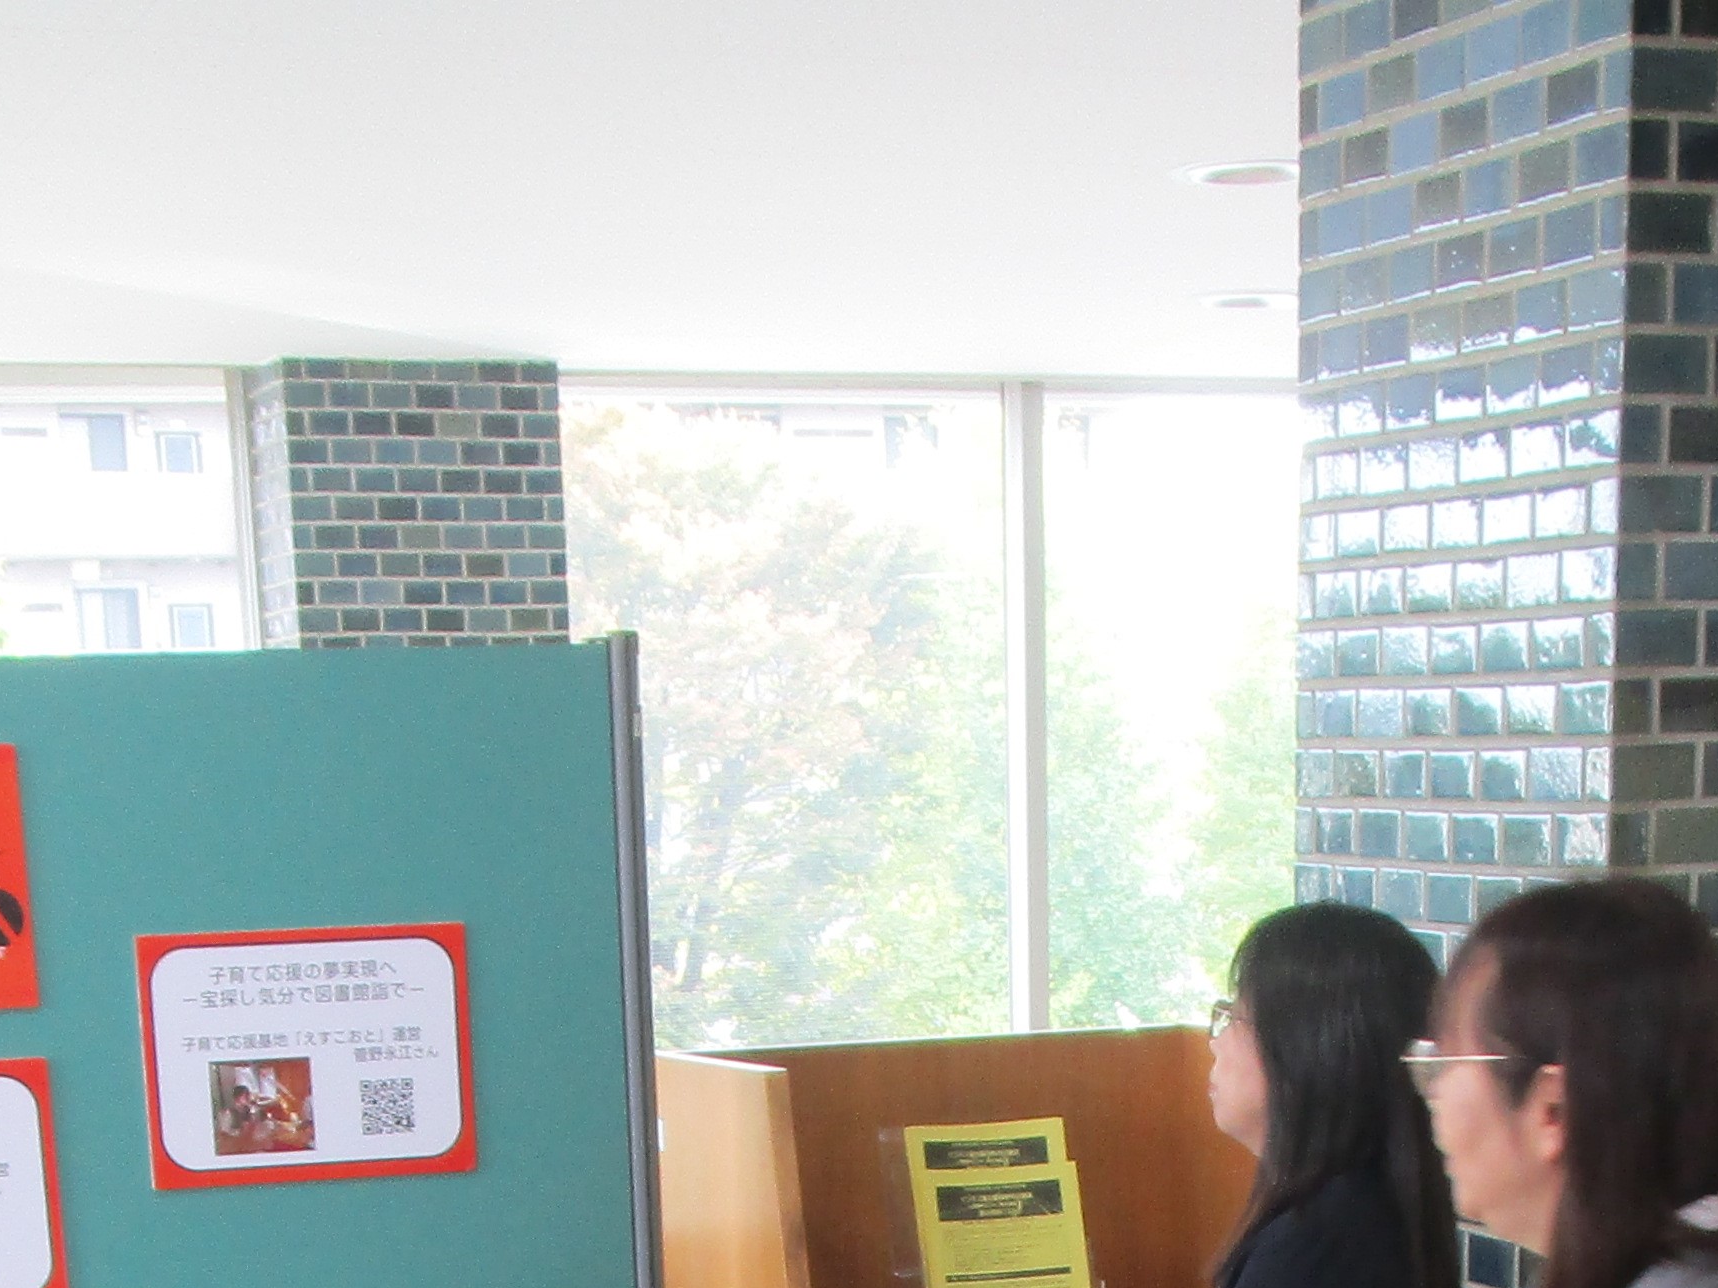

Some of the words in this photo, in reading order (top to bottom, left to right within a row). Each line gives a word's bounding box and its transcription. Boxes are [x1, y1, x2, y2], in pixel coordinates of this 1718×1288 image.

[209, 959, 397, 986] 子育て応援の夢実現へ
